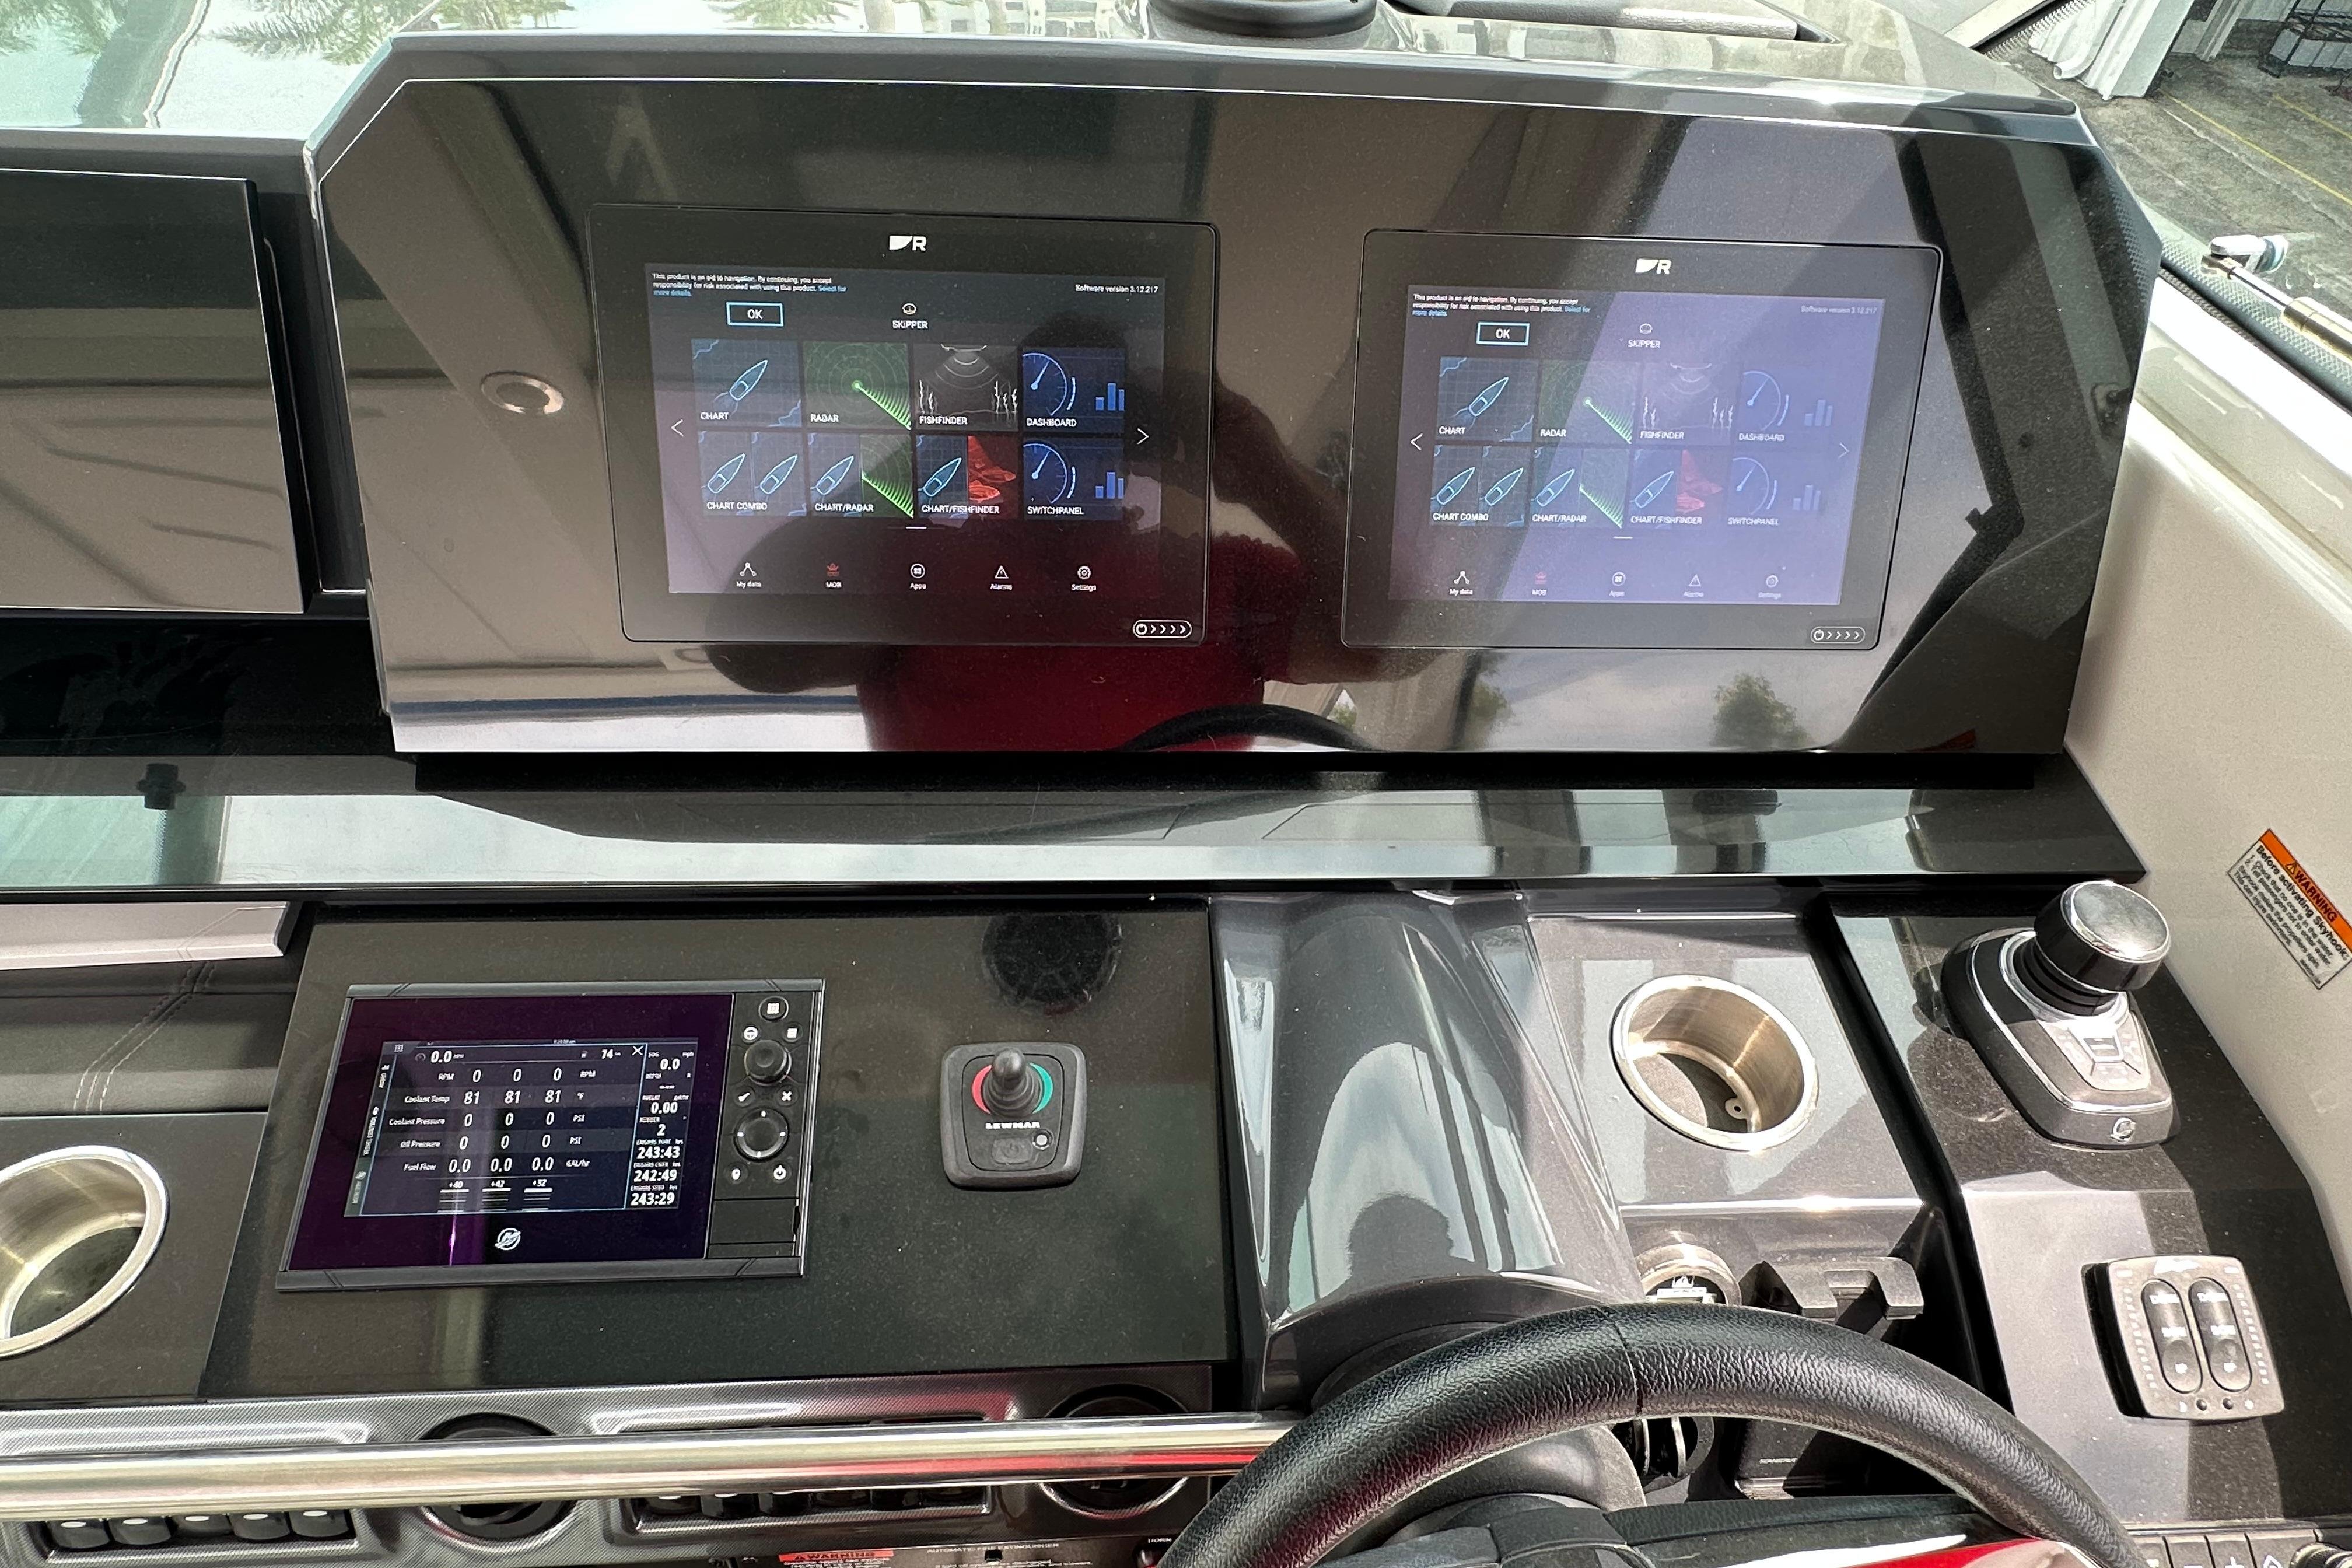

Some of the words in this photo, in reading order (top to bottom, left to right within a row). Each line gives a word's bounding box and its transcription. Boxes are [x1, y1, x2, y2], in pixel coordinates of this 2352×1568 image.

[1076, 284, 1104, 293] Software
[1130, 285, 1158, 293] 3.12.217
[747, 310, 763, 320] OK
[892, 320, 928, 330] SKIPPER
[1496, 328, 1510, 339] OK
[1628, 340, 1660, 349] SKIPPER
[700, 412, 729, 420] CHART
[811, 414, 839, 422] RADAR
[919, 416, 968, 425] FISHFINDER
[1027, 418, 1077, 427] DASHBOARD
[1540, 429, 1567, 437] RADAR
[1640, 431, 1685, 439] FISHFINDER
[1738, 433, 1785, 442] DASHBOARD
[707, 502, 734, 510] CHART
[737, 502, 767, 510] COMBO
[814, 503, 874, 512] CHART/RADAR
[922, 505, 1000, 514] CHART/FISHFINDER
[1027, 506, 1084, 515] SWITCHPANEL
[1433, 513, 1459, 521] CHART
[1532, 514, 1587, 523] CHART/RADAR
[1630, 516, 1702, 524] CHART/FISHFINDER
[1727, 517, 1779, 526] SWITCHPANEL
[1449, 588, 1459, 596] My
[2233, 872, 2245, 885] This
[2243, 884, 2253, 896] can
[2255, 845, 2281, 875] Before
[2277, 873, 2315, 918] activating
[2254, 861, 2271, 880] Check
[2270, 880, 2281, 892] that
[2279, 892, 2288, 901] no
[2287, 901, 2298, 914] one
[2307, 927, 2318, 938] the
[2293, 870, 2338, 922] WARNING
[2273, 911, 2284, 922] the
[2286, 912, 2296, 922] not
[2300, 929, 2315, 947] enter
[430, 1051, 452, 1063] 0.0
[601, 1049, 613, 1059] 74
[660, 1058, 680, 1070] 0.0
[473, 1069, 481, 1083] 0
[513, 1069, 521, 1082] 0
[553, 1068, 562, 1081] 0
[431, 1095, 450, 1104] Temp
[464, 1091, 480, 1104] 81
[505, 1090, 520, 1104] 81
[545, 1090, 561, 1103] 81
[650, 1101, 678, 1114] 0.00
[389, 1118, 414, 1126] Coolant
[464, 1113, 473, 1126] 0
[505, 1112, 513, 1126] 0
[546, 1112, 554, 1125] 0
[657, 1124, 666, 1136] 2
[985, 1121, 1041, 1129] LEWMAR
[460, 1136, 468, 1150] 0
[501, 1135, 510, 1149] 0
[542, 1135, 550, 1148] 0
[636, 1146, 680, 1159] 243:43
[404, 1163, 419, 1171] Fuel
[449, 1158, 471, 1173] 0.0
[490, 1158, 512, 1172] 0.0
[532, 1157, 554, 1171] 0.0
[634, 1169, 677, 1182] 242:49
[631, 1192, 675, 1206] 243:29
[807, 1552, 875, 1560] WARNING
